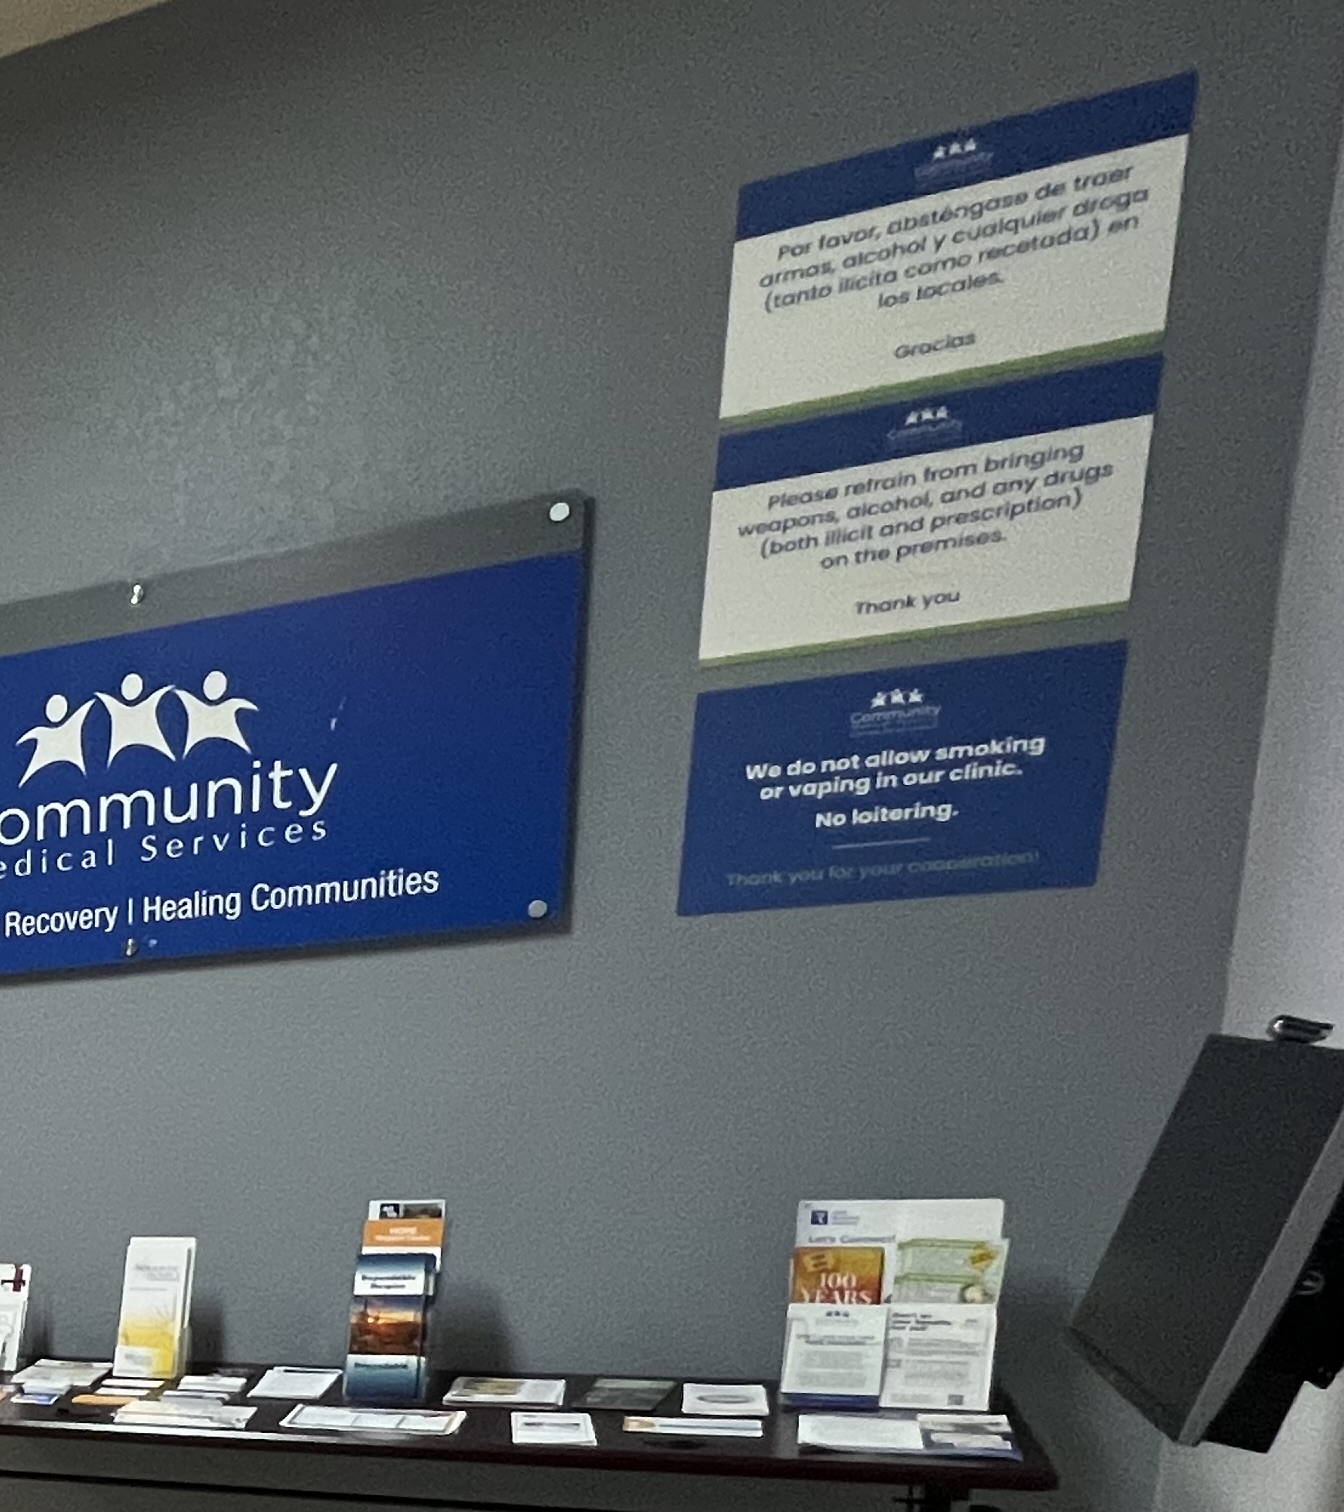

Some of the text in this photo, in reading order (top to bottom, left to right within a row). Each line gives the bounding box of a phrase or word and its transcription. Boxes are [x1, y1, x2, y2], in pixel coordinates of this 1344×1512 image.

[777, 241, 813, 261] Por
[818, 225, 881, 251] favor,
[1035, 181, 1066, 201] de
[1073, 165, 1134, 192] traer
[759, 188, 1149, 288] armas, alcohol y cualquier droga
[764, 284, 833, 313] (tanto
[904, 253, 972, 279] como
[978, 217, 1100, 263] recetada)
[1107, 215, 1139, 235] en
[878, 272, 1004, 308] los locales.
[894, 332, 976, 359] Gracias
[768, 444, 1085, 511] Please refrain from bringing
[737, 464, 1113, 537] weapons, alcohol, and any drugs
[761, 486, 1082, 559] (both illicit and prescription)
[820, 530, 1007, 569] on the premises.
[856, 591, 960, 615] Thank you
[746, 736, 1046, 780] We do not allow smoking
[760, 760, 1023, 800] or vaping in our clinic.
[816, 801, 959, 828] No loitering.
[140, 820, 327, 862] Services
[727, 870, 783, 886] Thank
[788, 868, 824, 885] you
[828, 865, 854, 879] for
[859, 862, 904, 880] your
[4, 905, 119, 938] Recovery
[142, 889, 241, 921] Healing
[251, 868, 440, 912] Communities
[801, 1290, 872, 1304] YEARS
[820, 1272, 857, 1289] 100
